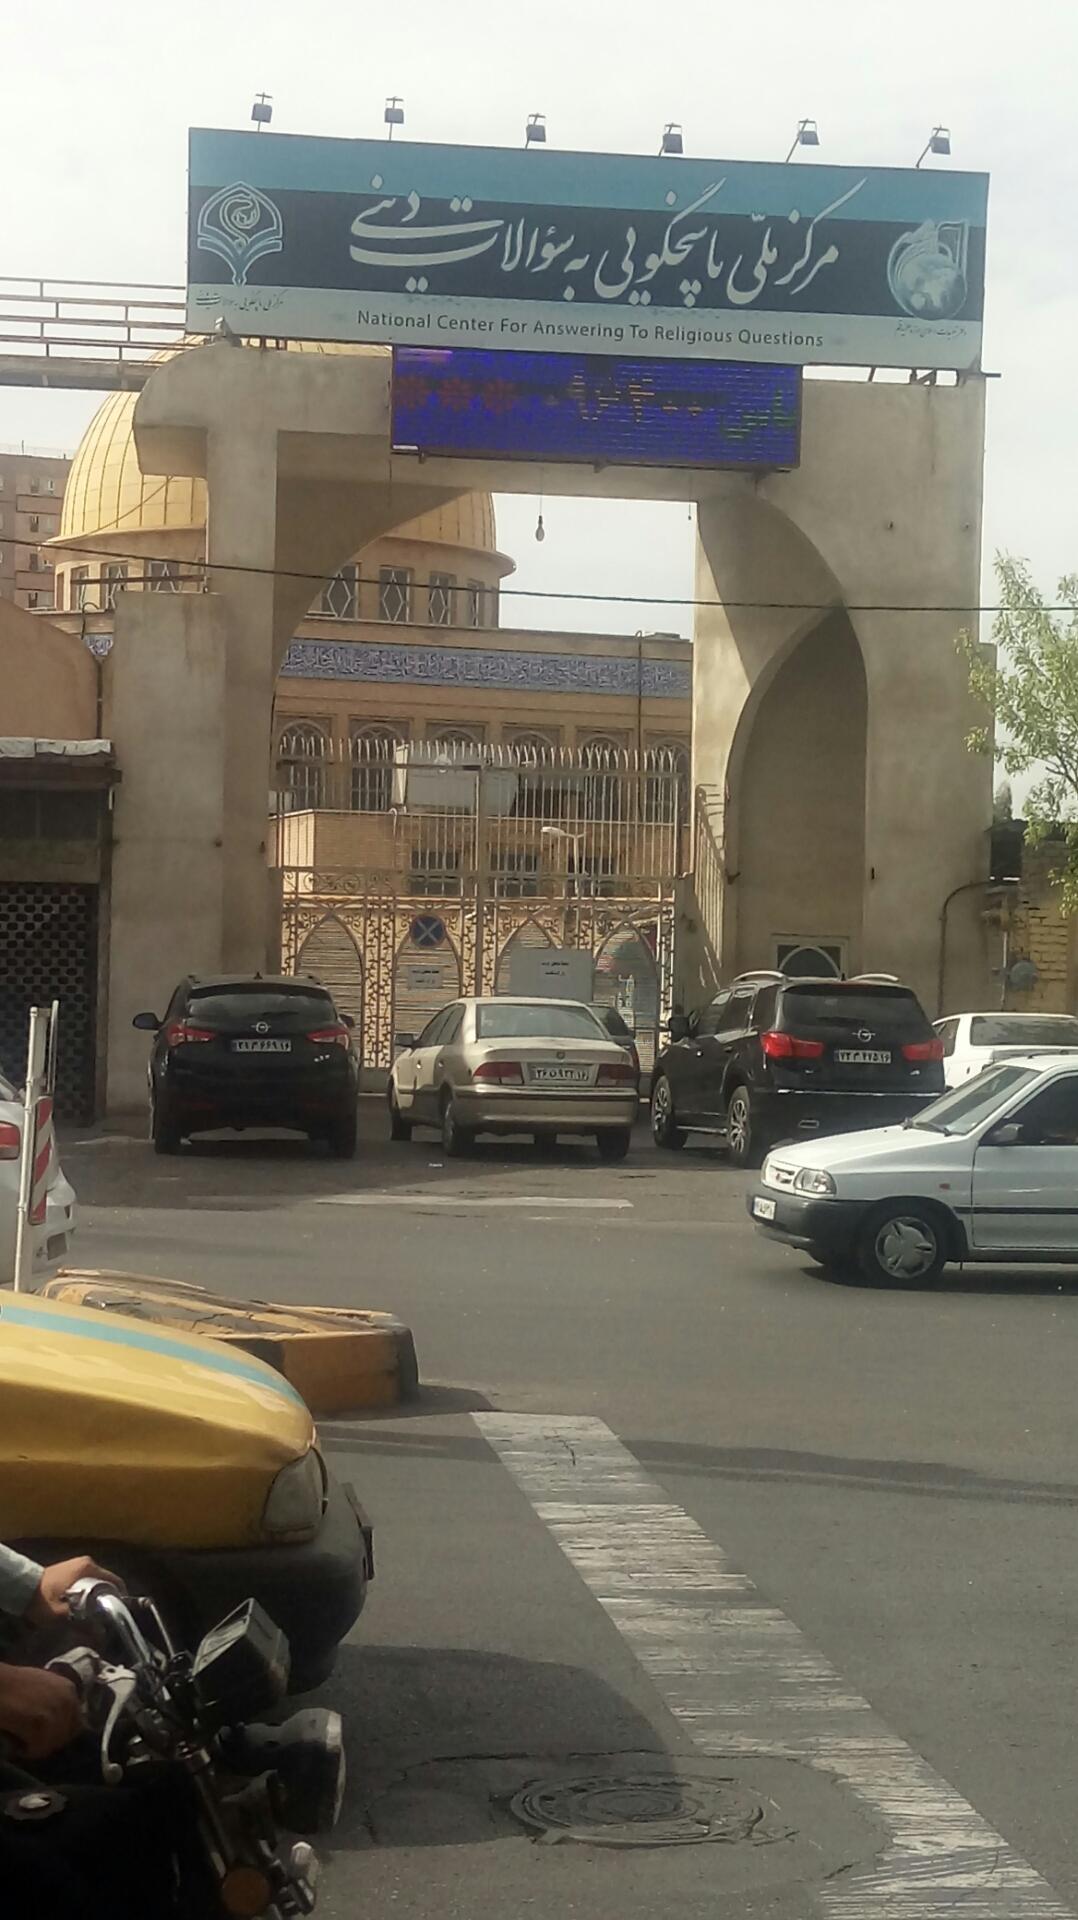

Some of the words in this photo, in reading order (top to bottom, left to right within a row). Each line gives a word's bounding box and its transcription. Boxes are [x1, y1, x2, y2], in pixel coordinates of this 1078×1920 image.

[563, 253, 591, 302] به
[594, 177, 727, 307] پاسخگویی
[774, 177, 867, 295] مرکز
[357, 310, 430, 329] National
[437, 315, 494, 332] Center
[500, 318, 528, 334] For
[533, 320, 624, 342] Answering
[629, 324, 648, 339] To
[655, 326, 732, 346] Religious
[738, 329, 824, 348] Questions
